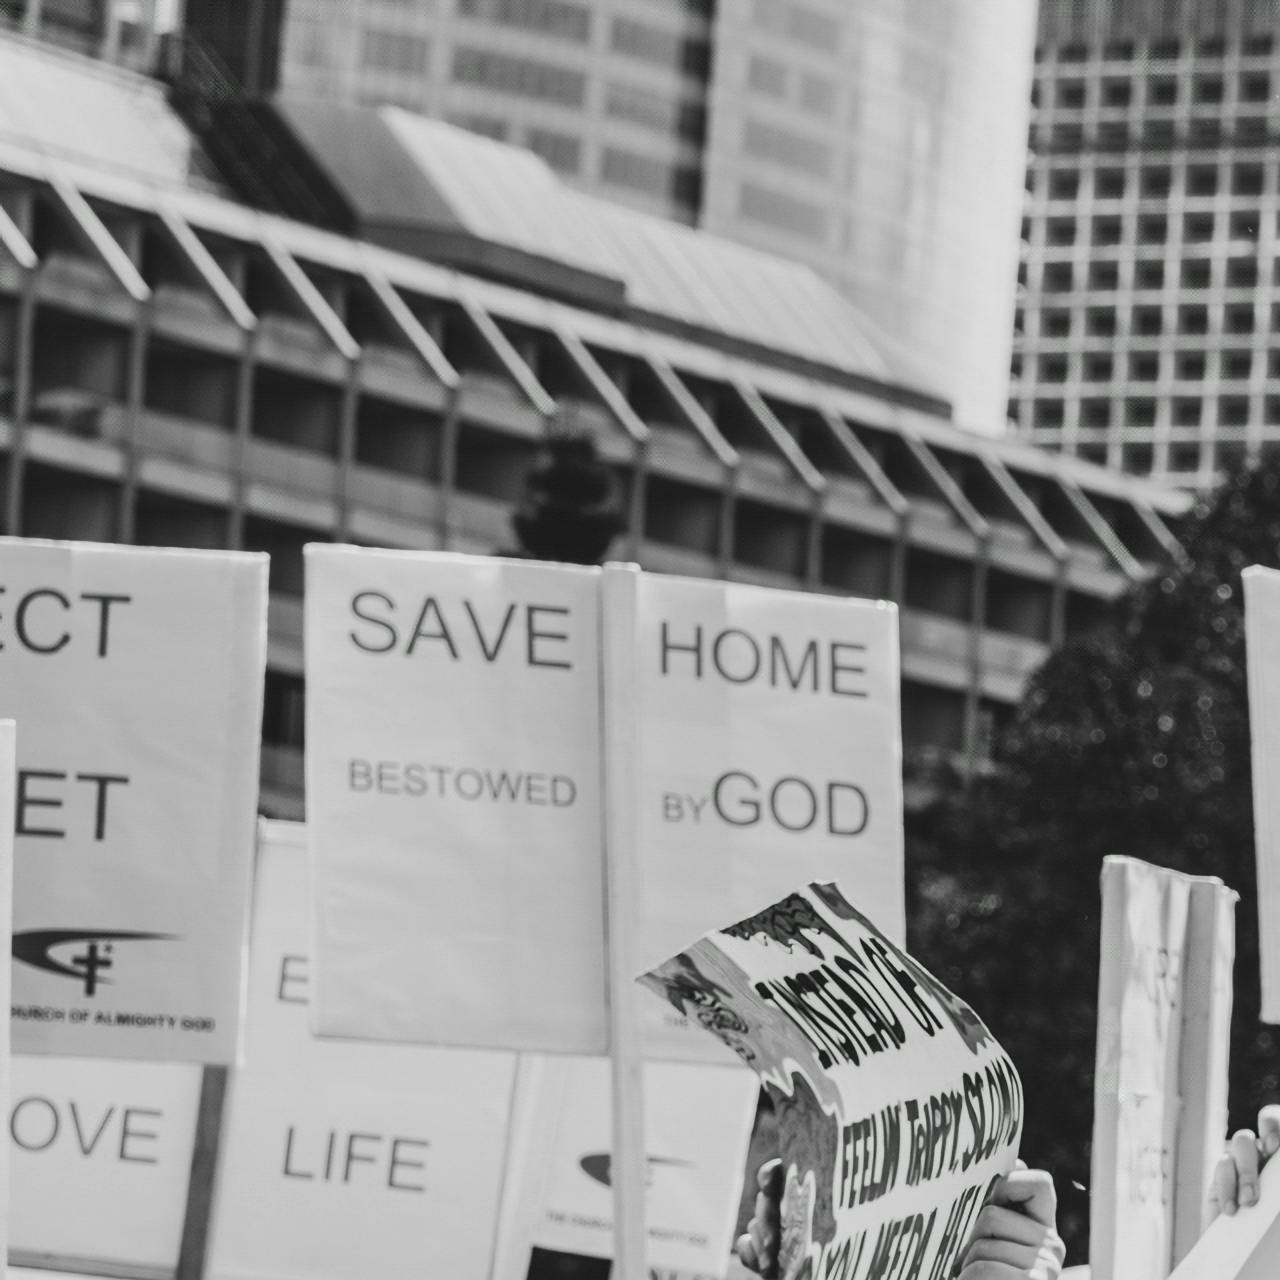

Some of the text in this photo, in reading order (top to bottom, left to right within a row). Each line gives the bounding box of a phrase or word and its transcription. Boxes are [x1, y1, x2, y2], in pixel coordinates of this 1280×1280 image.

[0, 587, 131, 657] CT
[350, 591, 869, 698] SAVE HOME
[348, 759, 578, 808] BESTOWED
[713, 771, 869, 836] GOD
[284, 1126, 430, 1192] LIFE
